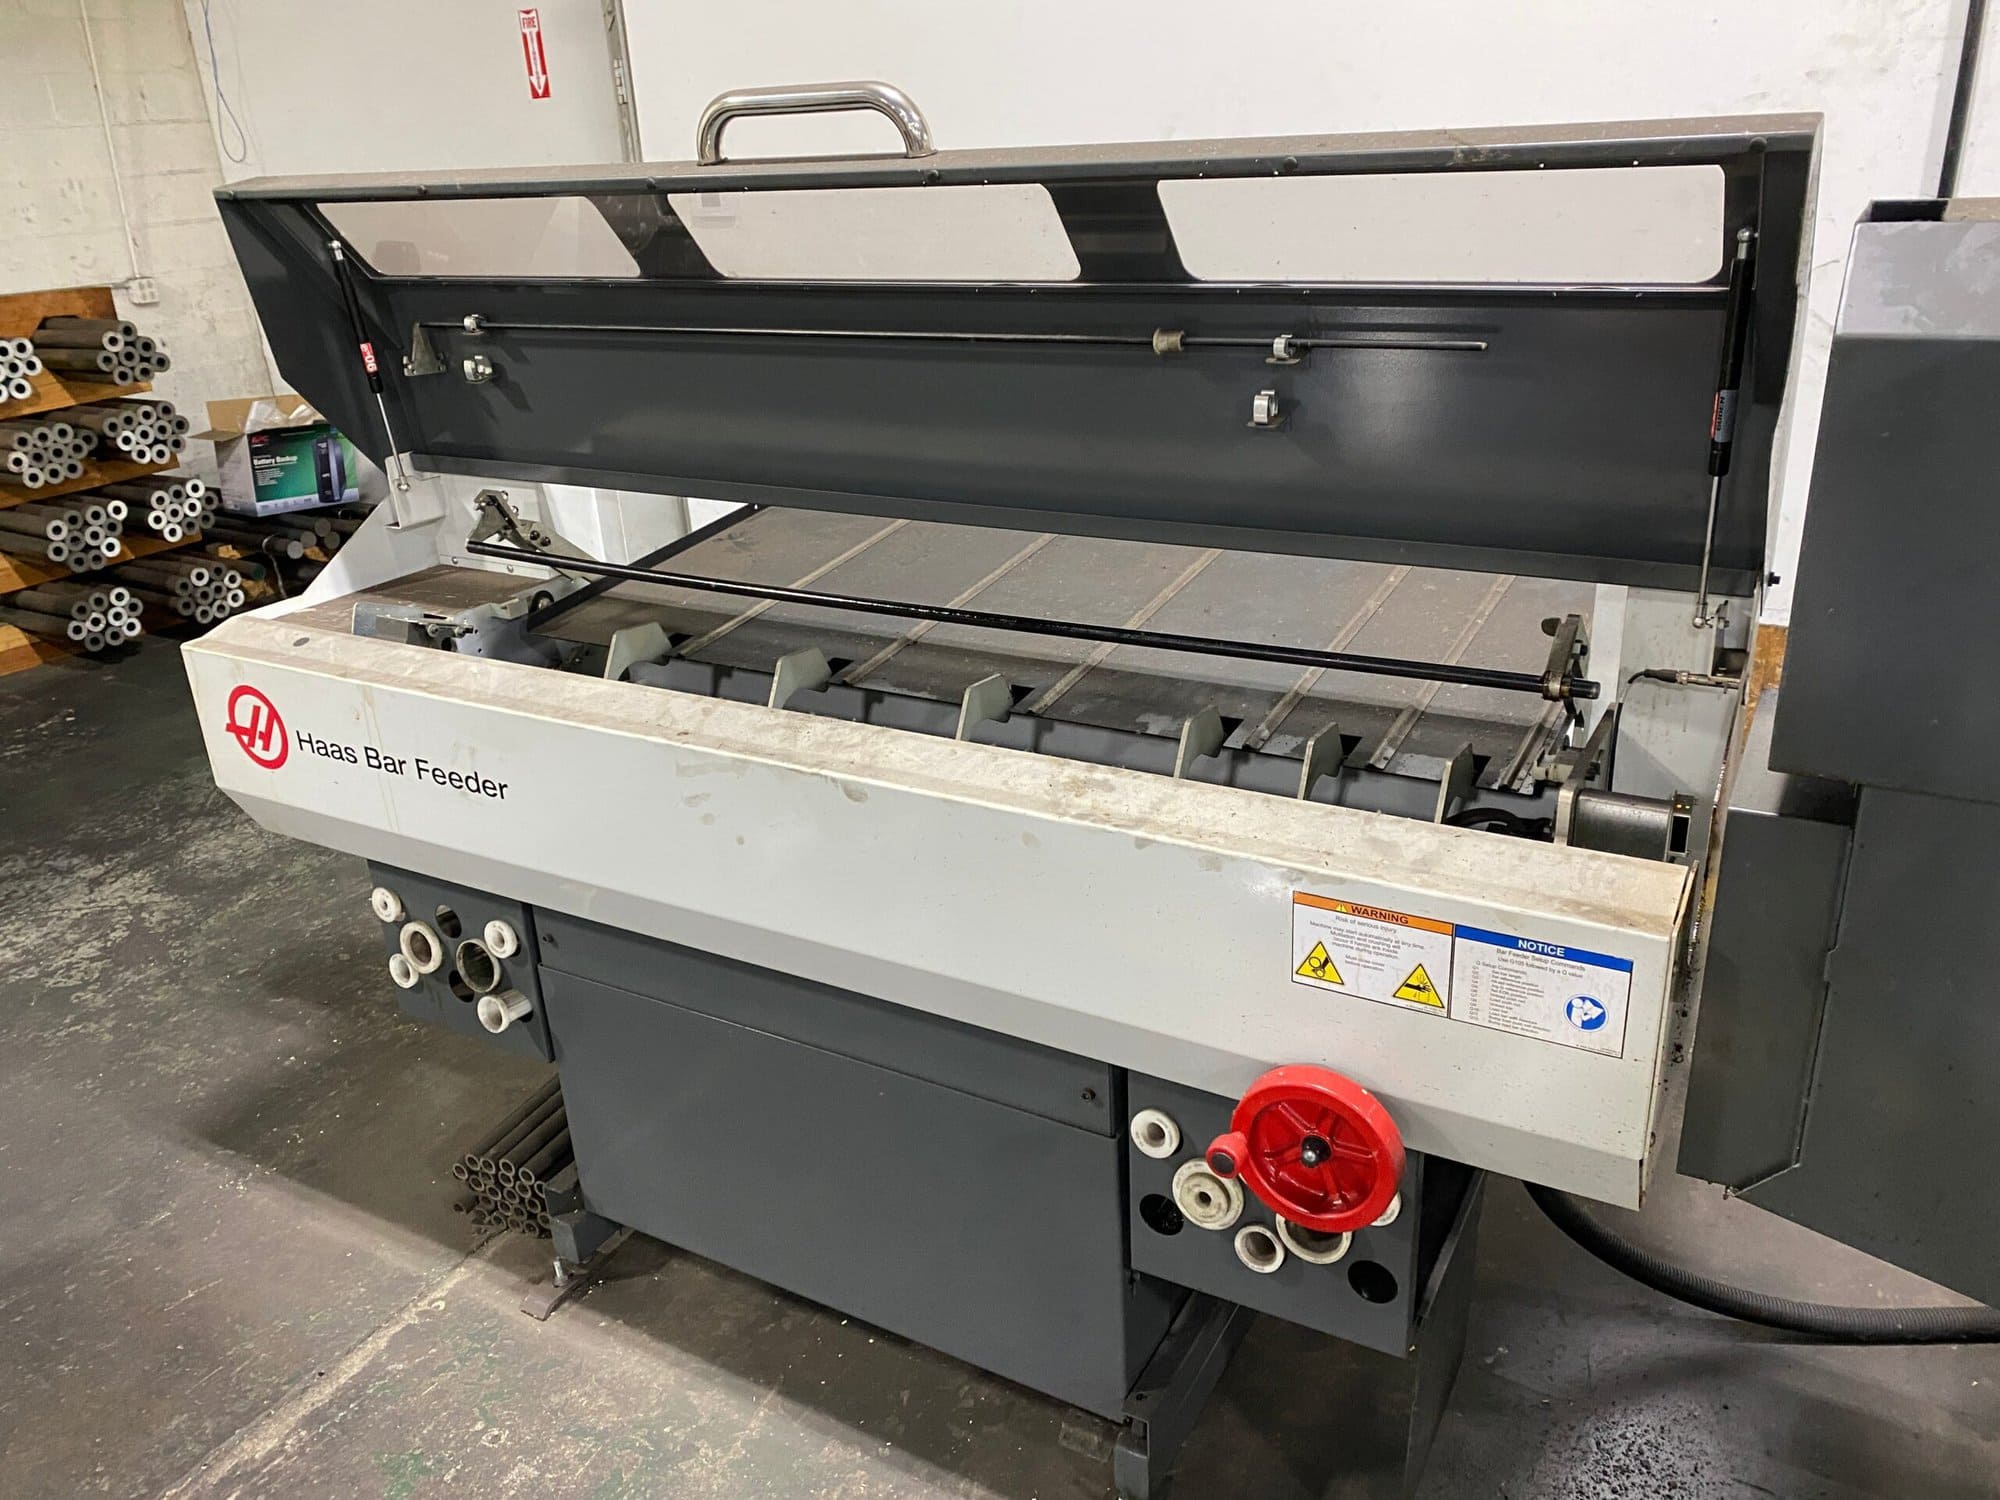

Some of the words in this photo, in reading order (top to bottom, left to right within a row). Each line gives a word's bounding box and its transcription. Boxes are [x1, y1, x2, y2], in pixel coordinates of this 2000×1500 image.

[296, 730, 358, 764] Haas
[364, 746, 407, 775] Bar
[415, 758, 508, 800] Feeder
[1351, 905, 1409, 925] WARNING
[1358, 920, 1378, 929] serious
[1381, 925, 1397, 934] injury
[1518, 939, 1565, 957] NOTICE
[1509, 951, 1530, 961] Feeder
[1532, 955, 1549, 965] Setup
[1551, 959, 1585, 972] Commands
